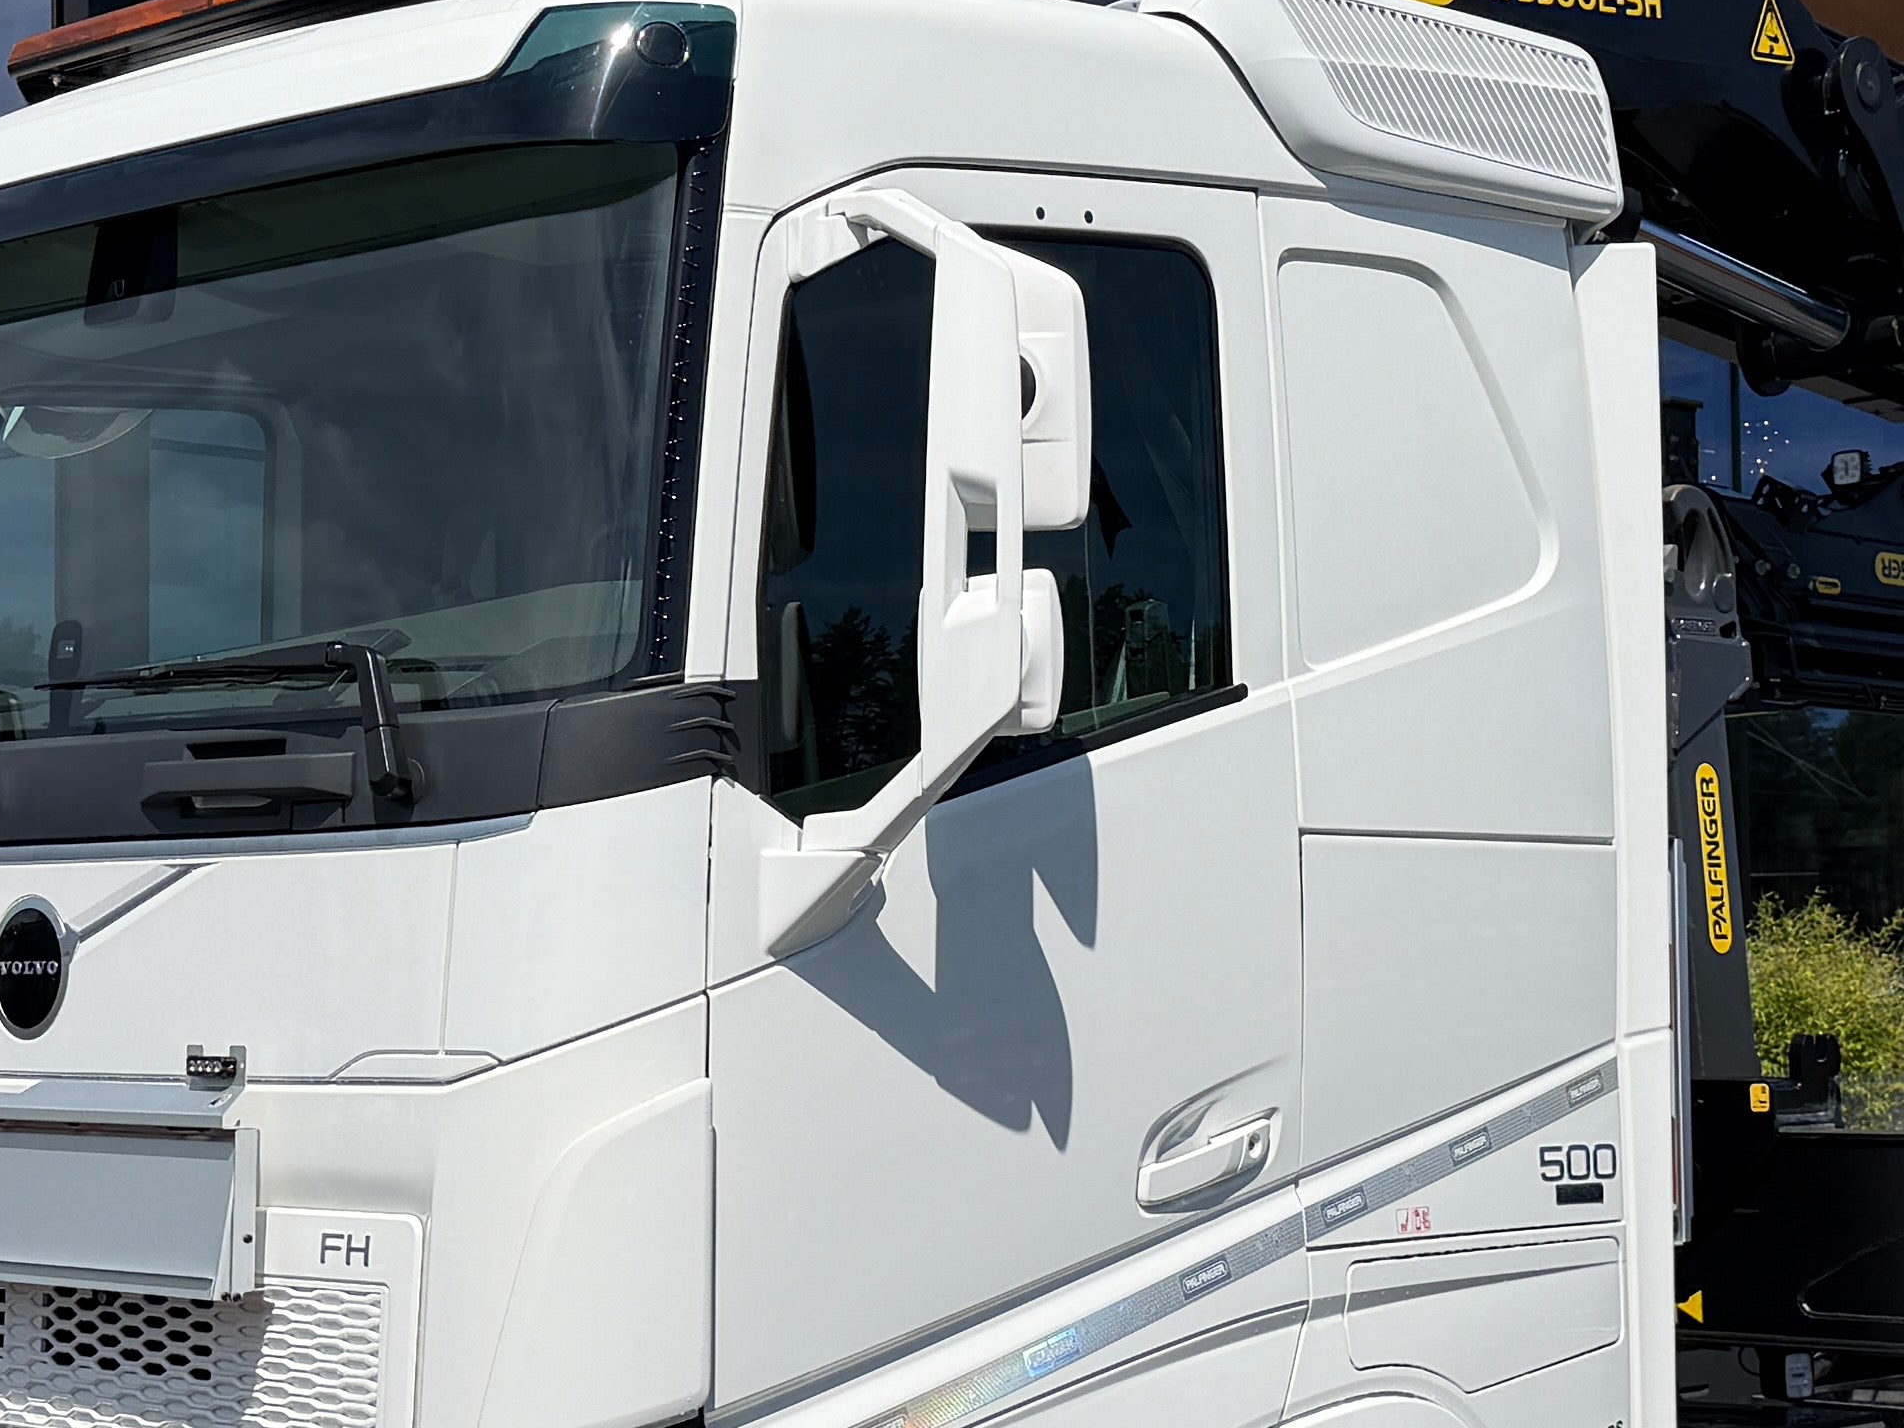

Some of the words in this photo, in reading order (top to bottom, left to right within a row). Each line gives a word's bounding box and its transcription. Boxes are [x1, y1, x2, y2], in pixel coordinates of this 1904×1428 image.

[1699, 776, 1730, 941] PALFINGER
[1539, 1143, 1617, 1182] 500
[319, 1232, 371, 1267] FH
